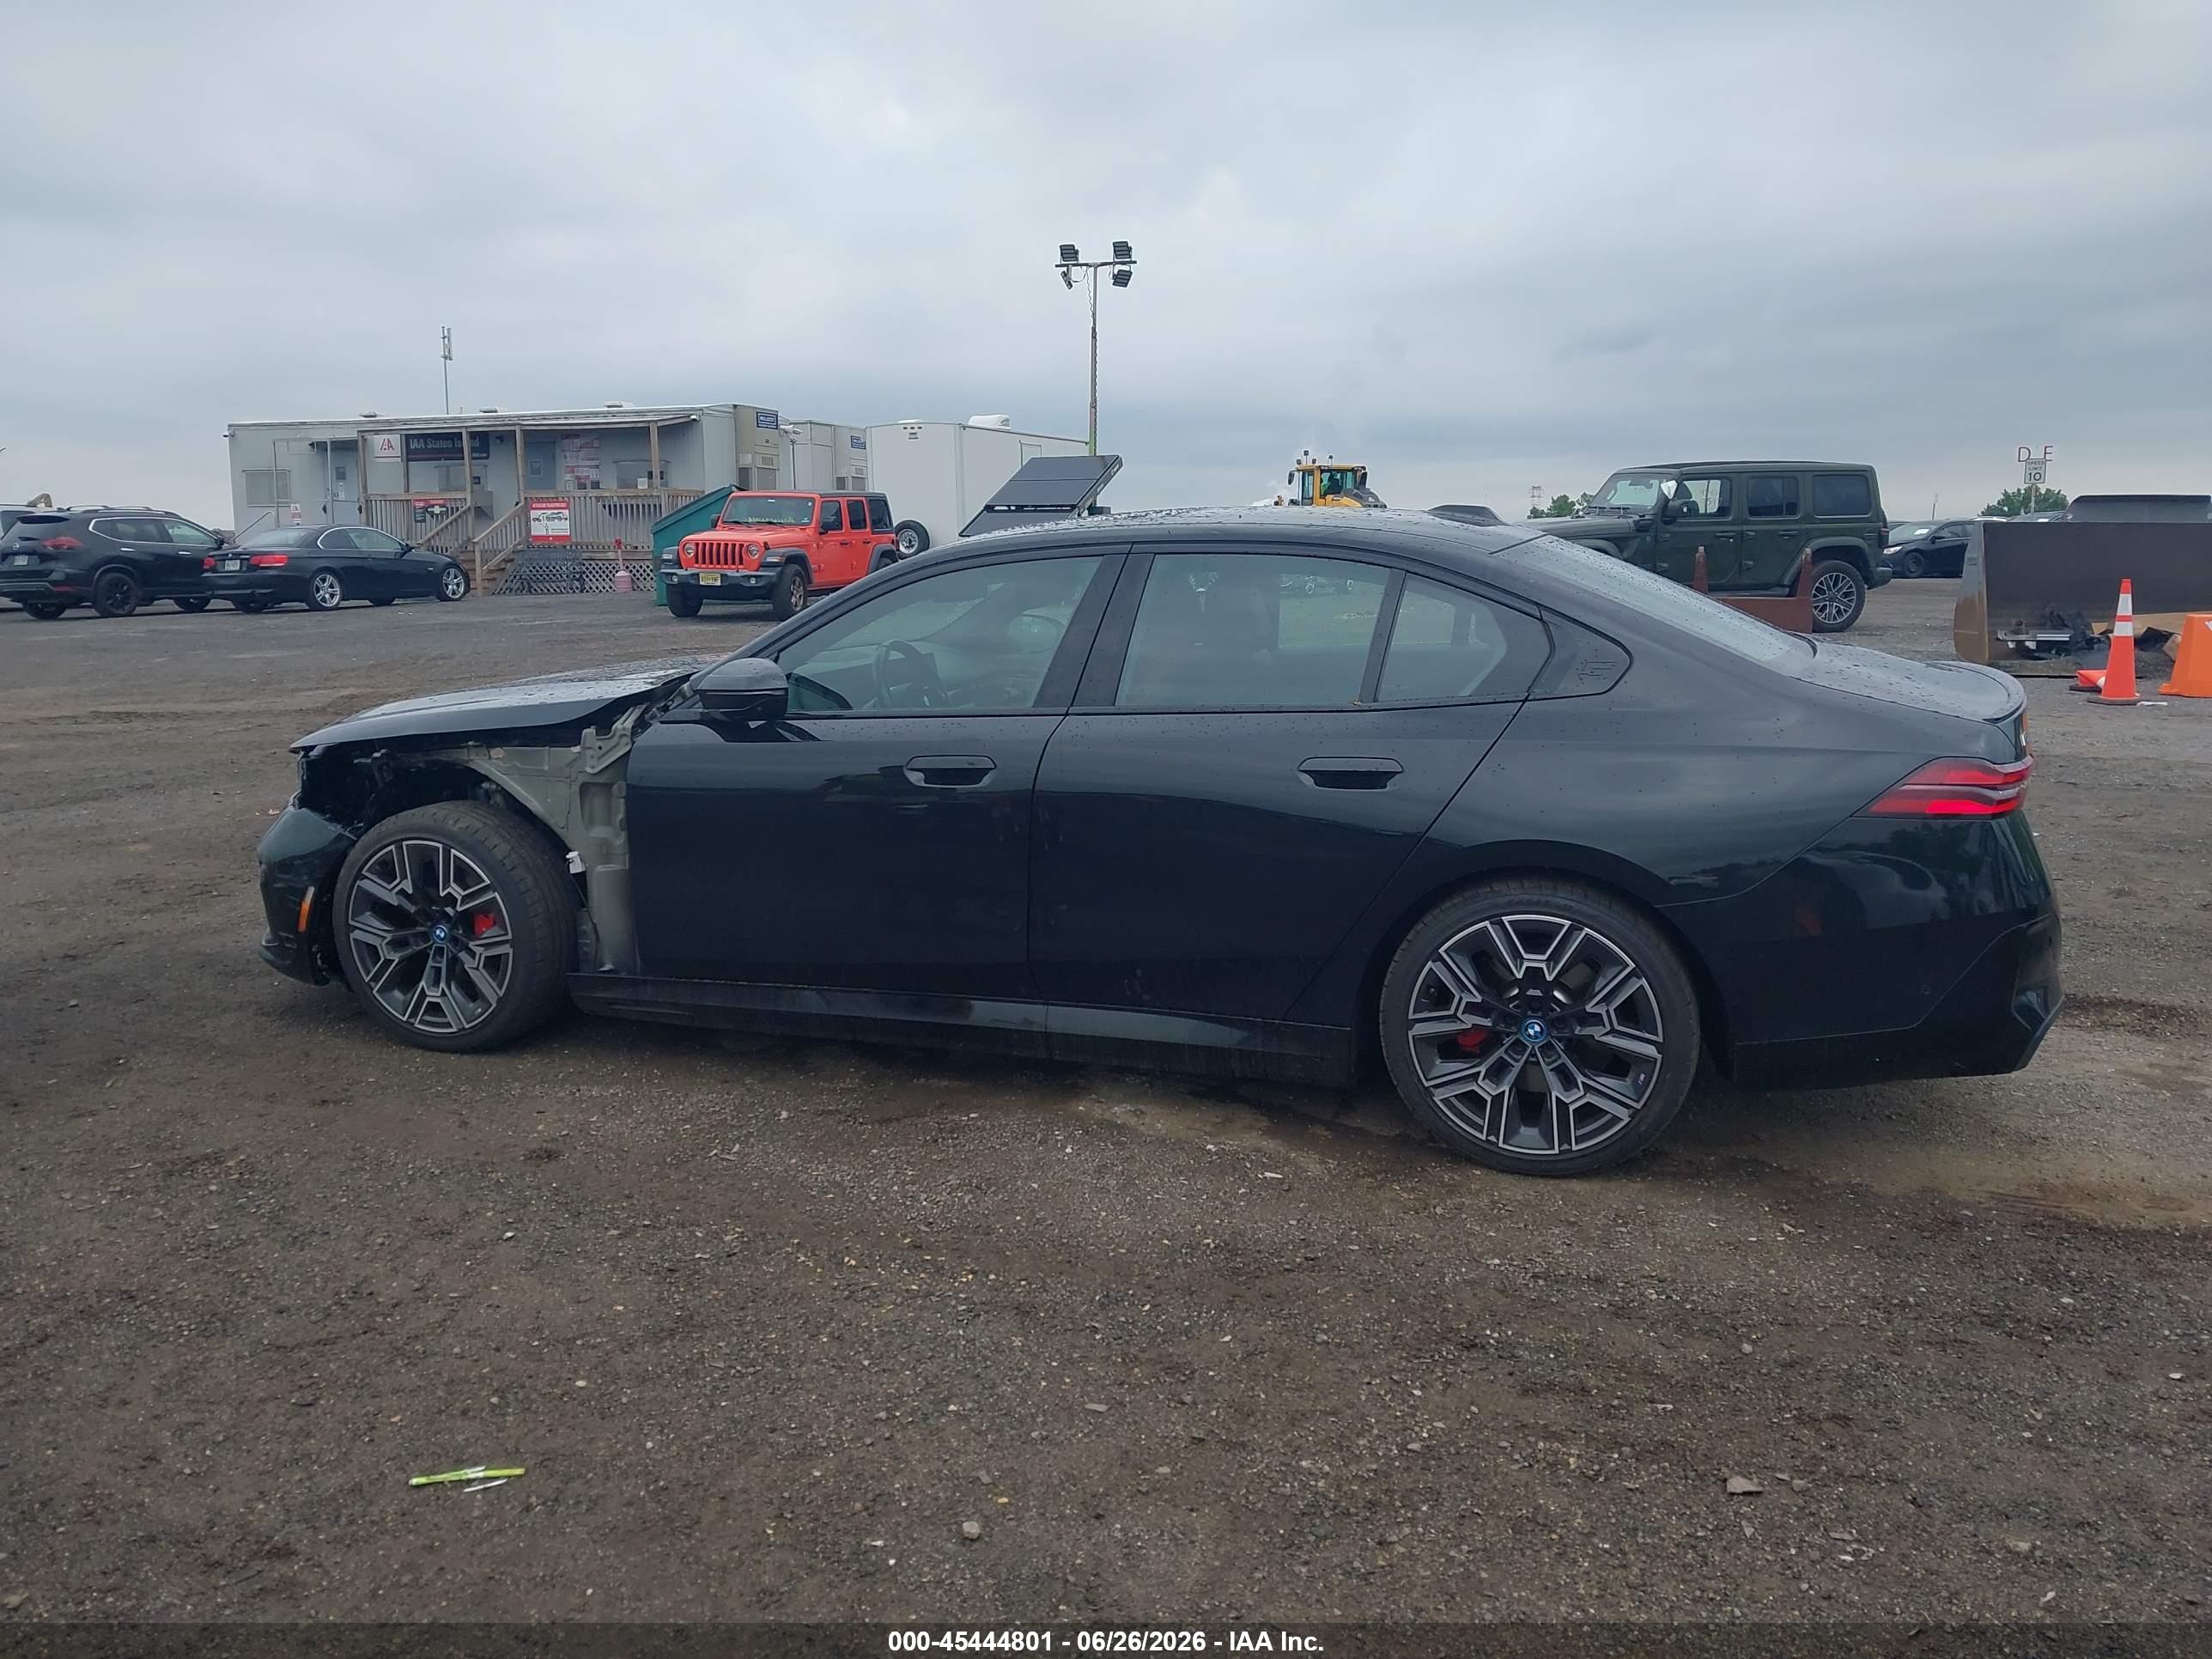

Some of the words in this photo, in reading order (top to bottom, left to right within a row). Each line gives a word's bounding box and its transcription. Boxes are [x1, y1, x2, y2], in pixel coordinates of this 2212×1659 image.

[410, 438, 425, 449] IAA
[426, 438, 453, 448] Staten
[454, 435, 479, 447] Isnd
[2018, 447, 2031, 462] D
[2045, 446, 2053, 461] E
[2028, 472, 2042, 481] 10
